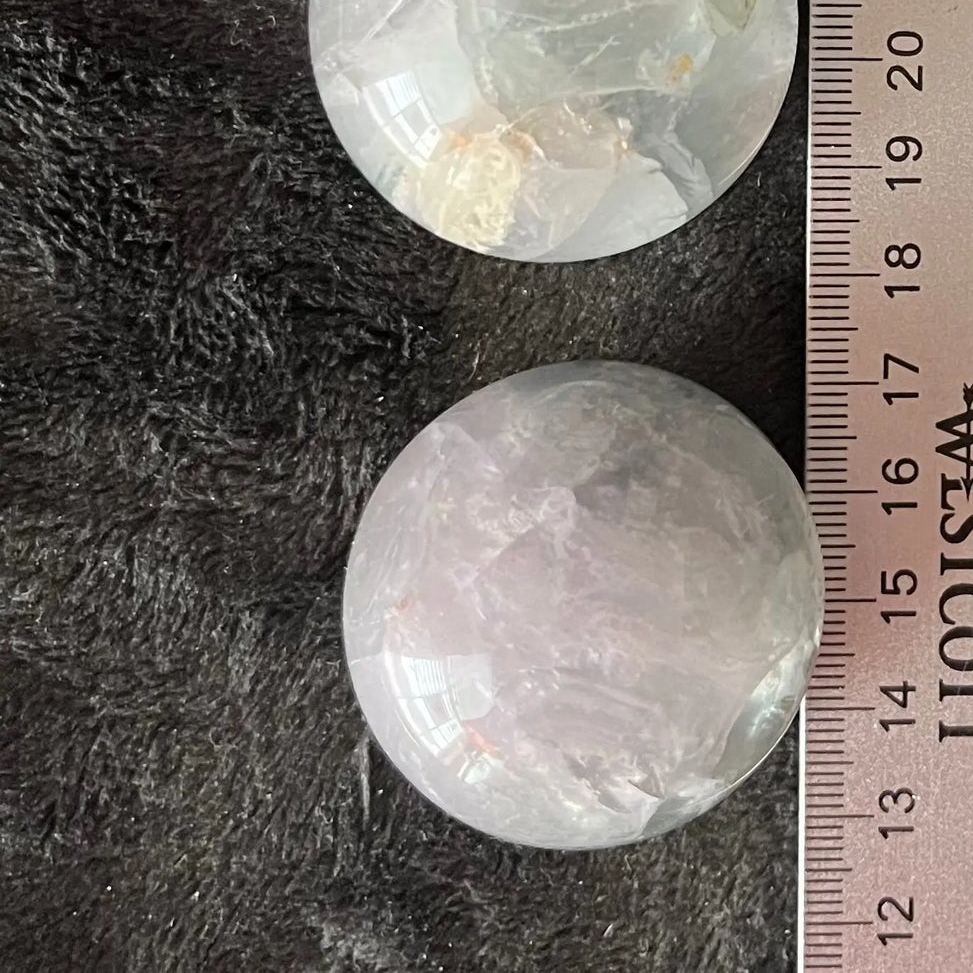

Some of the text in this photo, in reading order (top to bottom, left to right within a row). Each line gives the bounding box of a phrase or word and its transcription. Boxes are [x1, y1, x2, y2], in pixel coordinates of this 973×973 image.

[887, 31, 923, 91] 20
[885, 136, 922, 191] 19
[884, 243, 921, 298] 18
[883, 353, 919, 405] 17
[882, 458, 919, 515] 16
[881, 569, 917, 624] 15
[879, 681, 916, 732] 14
[878, 788, 915, 839] 13
[877, 897, 914, 946] 12
